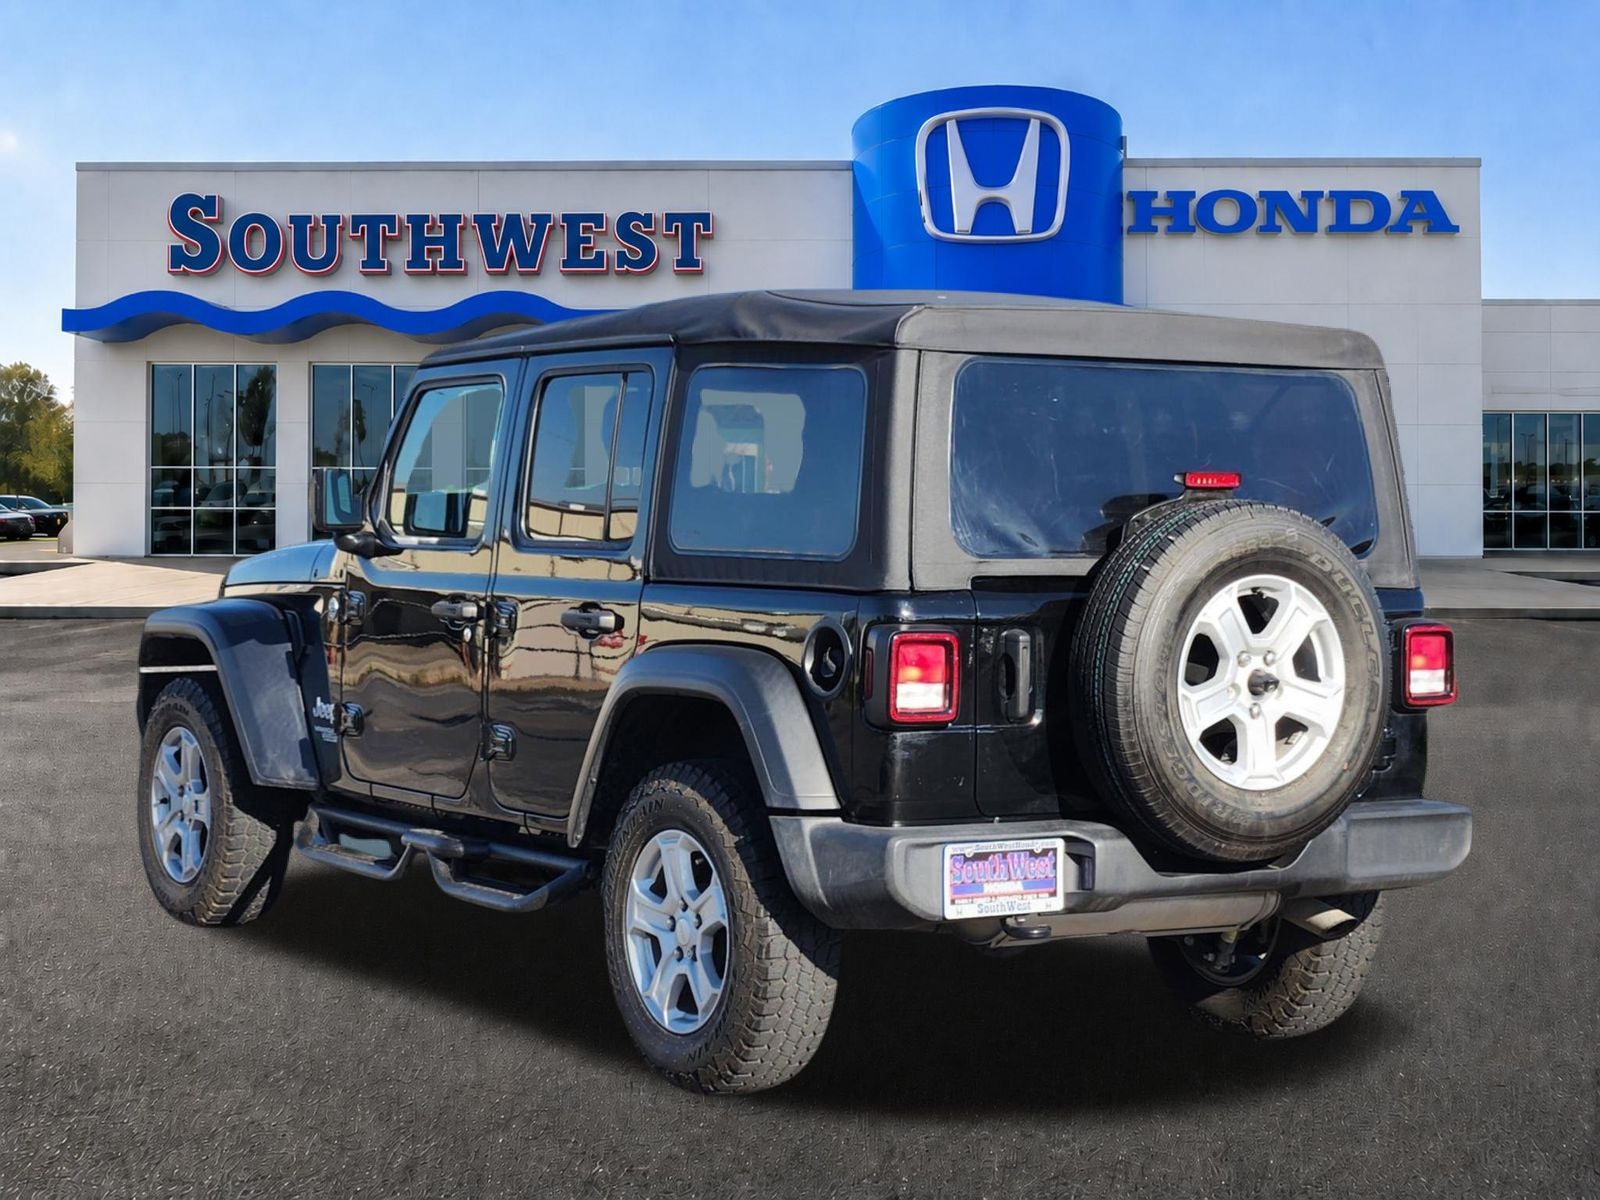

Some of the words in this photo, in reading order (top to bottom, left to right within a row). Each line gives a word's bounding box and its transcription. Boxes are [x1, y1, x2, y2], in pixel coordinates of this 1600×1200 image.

[1127, 189, 1460, 235] HONDA
[950, 850, 1057, 885] SouthWest
[976, 901, 1032, 914] SouthWest
